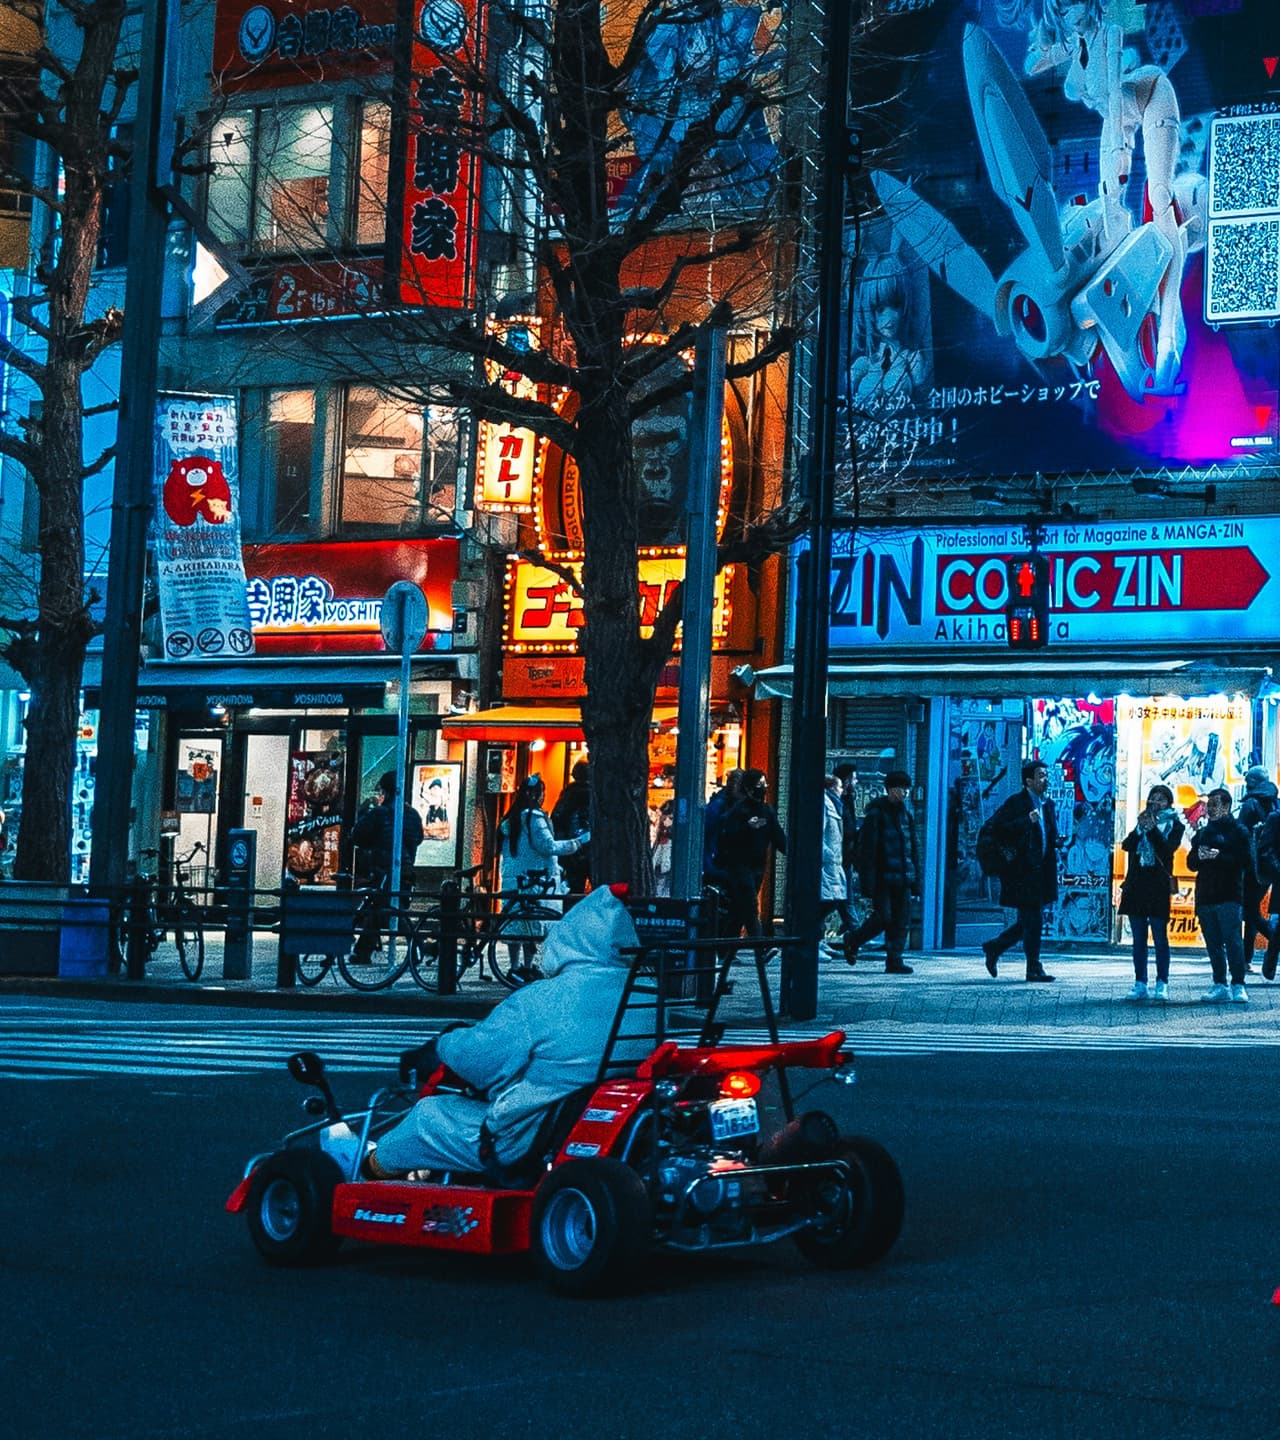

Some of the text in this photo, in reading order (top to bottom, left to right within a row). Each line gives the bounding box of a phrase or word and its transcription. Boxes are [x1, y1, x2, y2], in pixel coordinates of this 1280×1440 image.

[936, 523, 1244, 547] Professional for Magazine & MANGA-ZIN
[175, 561, 242, 575] AKIHABARA
[940, 554, 1182, 611] COIC ZIN
